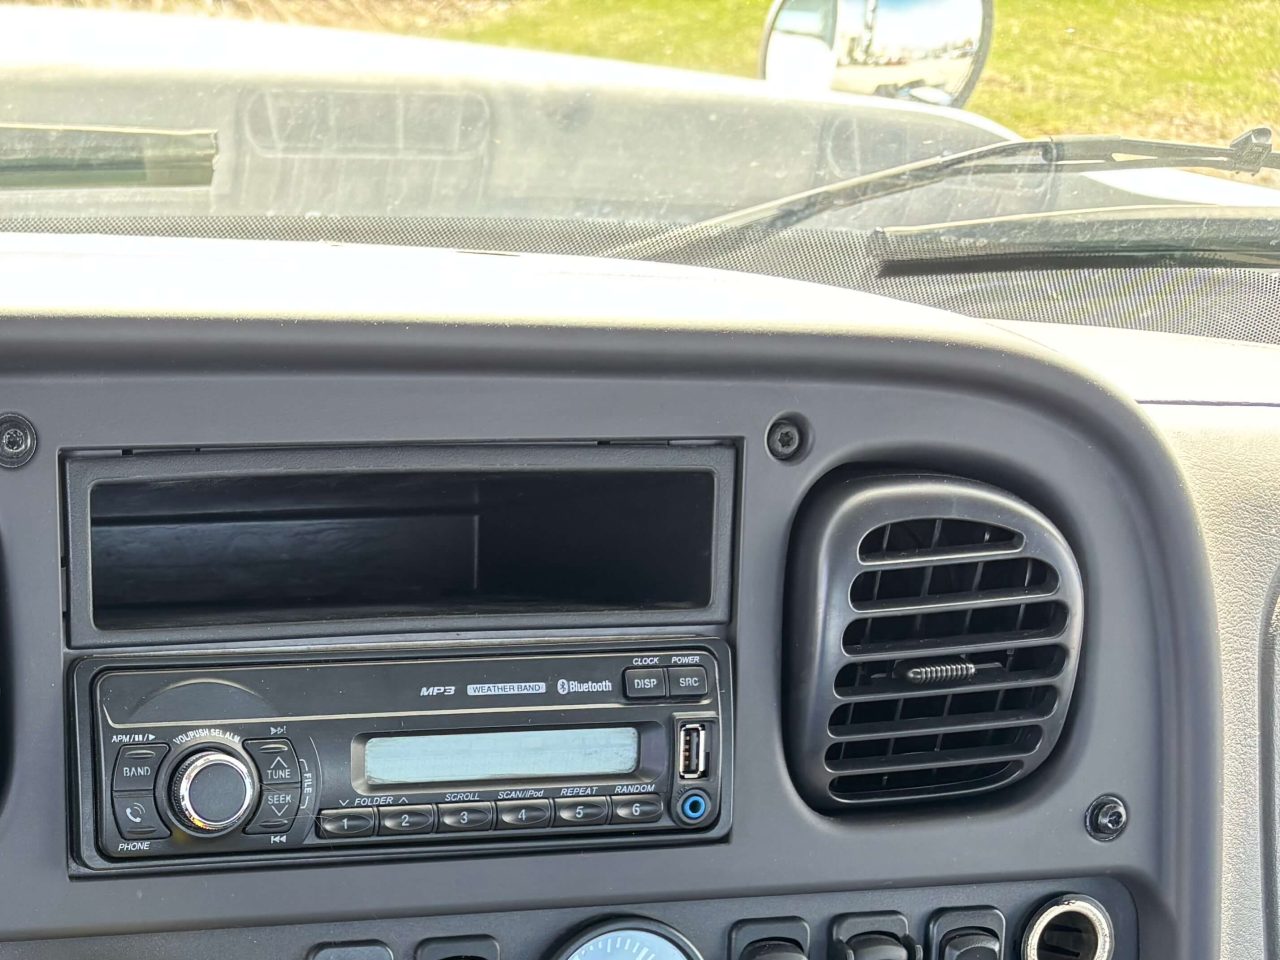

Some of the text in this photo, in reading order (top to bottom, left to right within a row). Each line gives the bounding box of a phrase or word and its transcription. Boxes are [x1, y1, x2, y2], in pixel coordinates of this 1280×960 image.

[632, 655, 700, 665] CLOCK POWER
[420, 679, 612, 697] MP3 WEATHER BAND Bluetooth
[634, 678, 657, 690] DISP
[679, 677, 700, 688] SRC
[123, 766, 151, 778] BAND
[267, 768, 291, 779] TUNE
[303, 772, 313, 794] FILE
[614, 784, 656, 794] RANDOM
[444, 792, 480, 802] SCROLL
[560, 786, 599, 796] REPEAT
[267, 794, 292, 805] SEEK
[354, 796, 394, 806] FOLDER
[518, 808, 527, 821] 4
[575, 805, 584, 818] 5
[632, 802, 641, 816] 6
[401, 814, 410, 827] 2
[460, 811, 468, 824] 3
[342, 818, 349, 830] 1
[117, 841, 151, 852] PHONE
